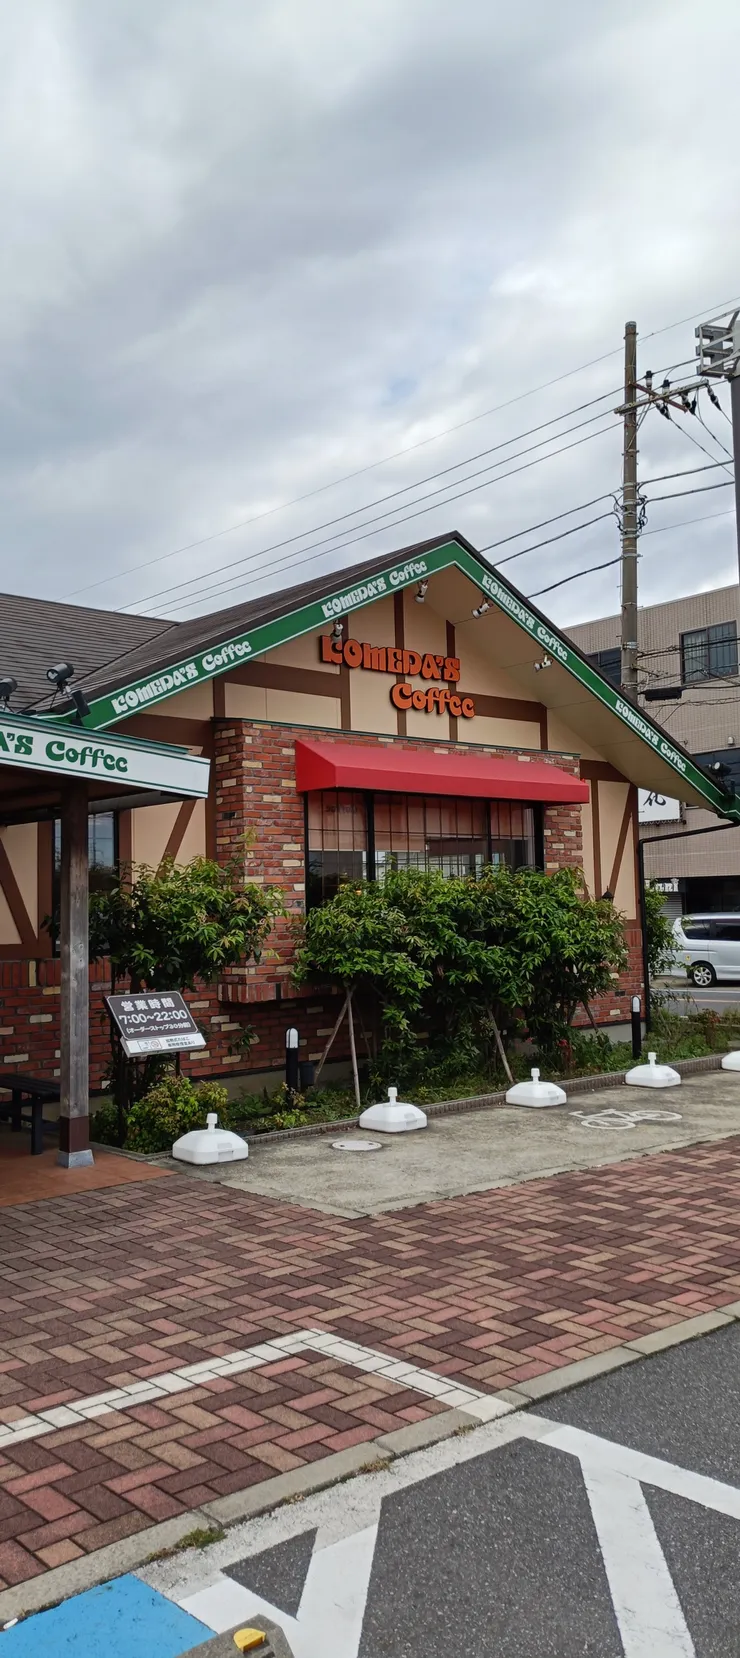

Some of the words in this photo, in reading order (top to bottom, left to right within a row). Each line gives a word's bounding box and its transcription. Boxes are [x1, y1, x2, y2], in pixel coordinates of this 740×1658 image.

[321, 577, 387, 618] KOMEDA'S
[389, 560, 427, 587] Coffee
[481, 574, 535, 630] KOMEDA'S
[536, 627, 568, 661] Coffee
[111, 662, 199, 715] KOMEDA'S
[201, 640, 253, 672] Coffee
[320, 635, 461, 683] KOMEDA'S
[391, 682, 475, 718] Coffee
[45, 740, 129, 773] Coffee
[615, 700, 659, 745] KOMEDA'S
[660, 742, 687, 772] Coffee
[121, 997, 175, 1011] 営業時間
